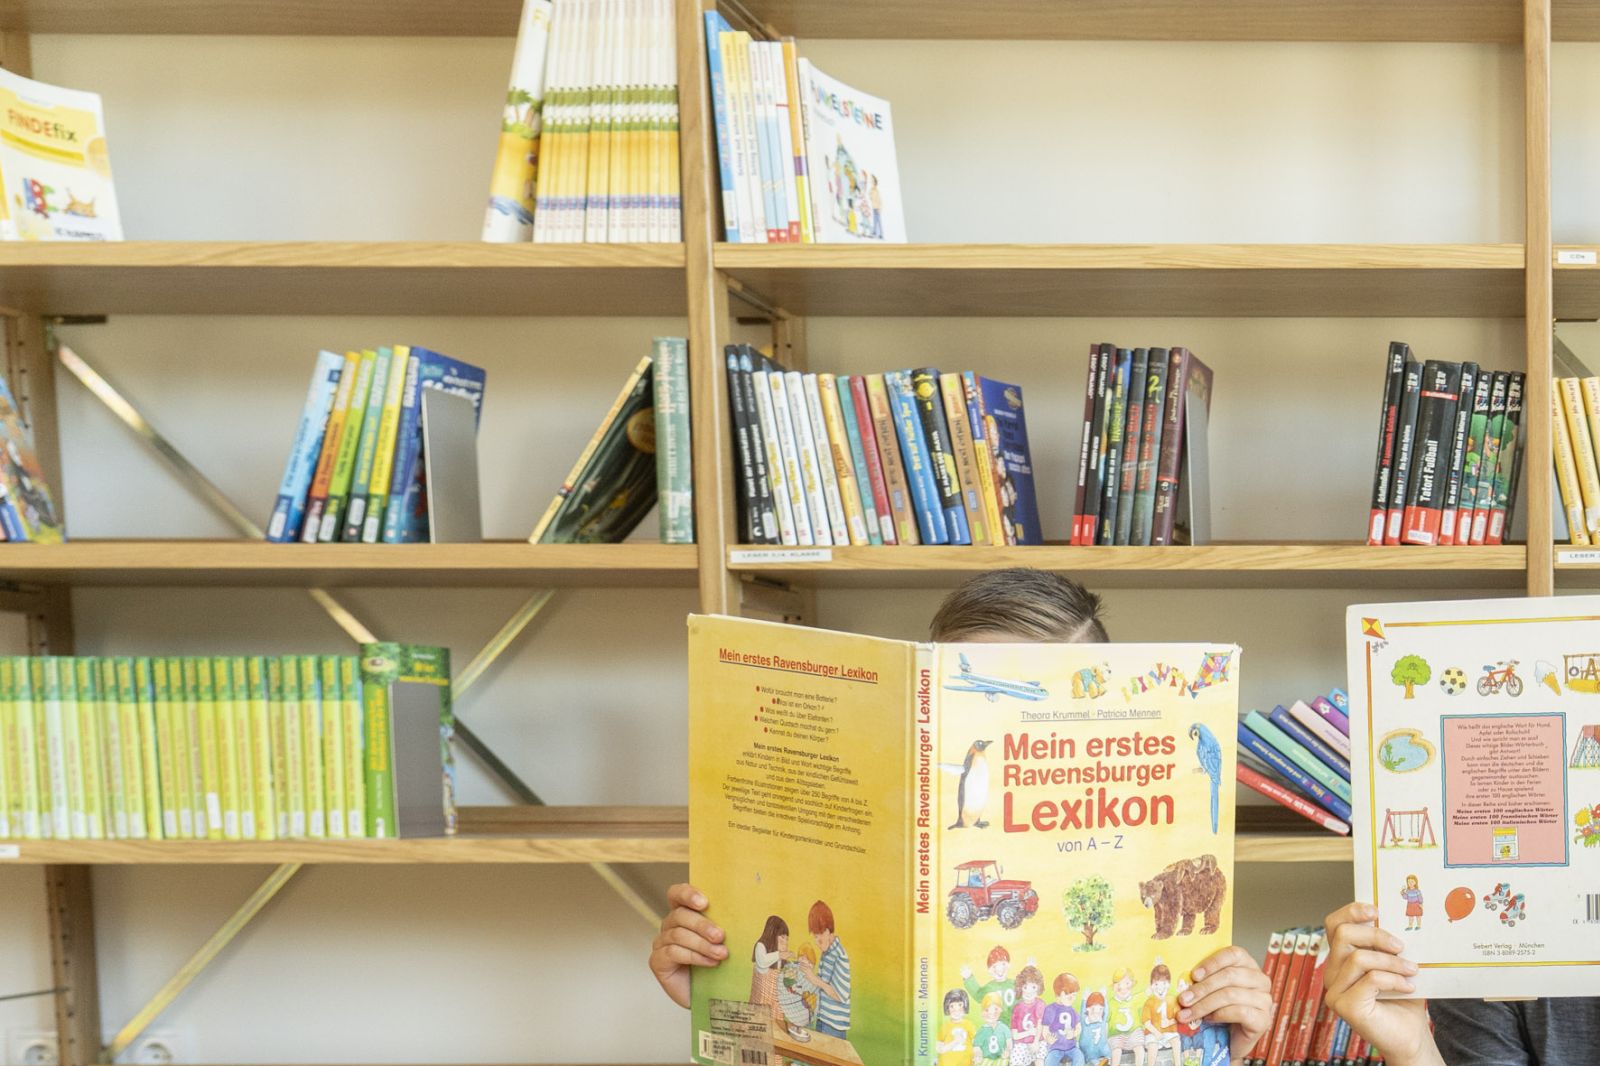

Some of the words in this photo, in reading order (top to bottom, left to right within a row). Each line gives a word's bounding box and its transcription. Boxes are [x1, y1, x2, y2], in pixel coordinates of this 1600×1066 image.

[1424, 441, 1438, 473] Fußball
[1420, 474, 1434, 502] Tatort
[719, 648, 741, 662] Mein
[743, 653, 771, 666] erstes
[774, 656, 838, 677] Ravensburger
[841, 665, 878, 681] Lexikon
[918, 668, 930, 724] Lexikon
[1021, 710, 1050, 720] Theora
[1053, 709, 1090, 719] Krummel
[1097, 708, 1128, 719] Patricia
[1130, 708, 1162, 719] Mennen
[1004, 732, 1075, 761] Mein
[1086, 732, 1176, 757] erstes
[917, 728, 932, 828] Ravensburger
[1004, 761, 1176, 787] Ravensburger
[1003, 787, 1174, 833] Lexikon
[918, 832, 930, 876] erstes
[1057, 839, 1083, 853] von
[1087, 837, 1097, 851] A
[1114, 835, 1124, 849] Z
[916, 880, 929, 913] Mein
[918, 957, 928, 999] Mennen
[1022, 1015, 1034, 1031] 6
[1058, 1012, 1072, 1036] 9
[1115, 1008, 1135, 1032] 3
[1156, 1003, 1170, 1028] 1
[918, 1011, 928, 1056] Krummel
[951, 1028, 968, 1052] 2
[988, 1035, 999, 1054] 8
[1091, 1028, 1101, 1045] 7
